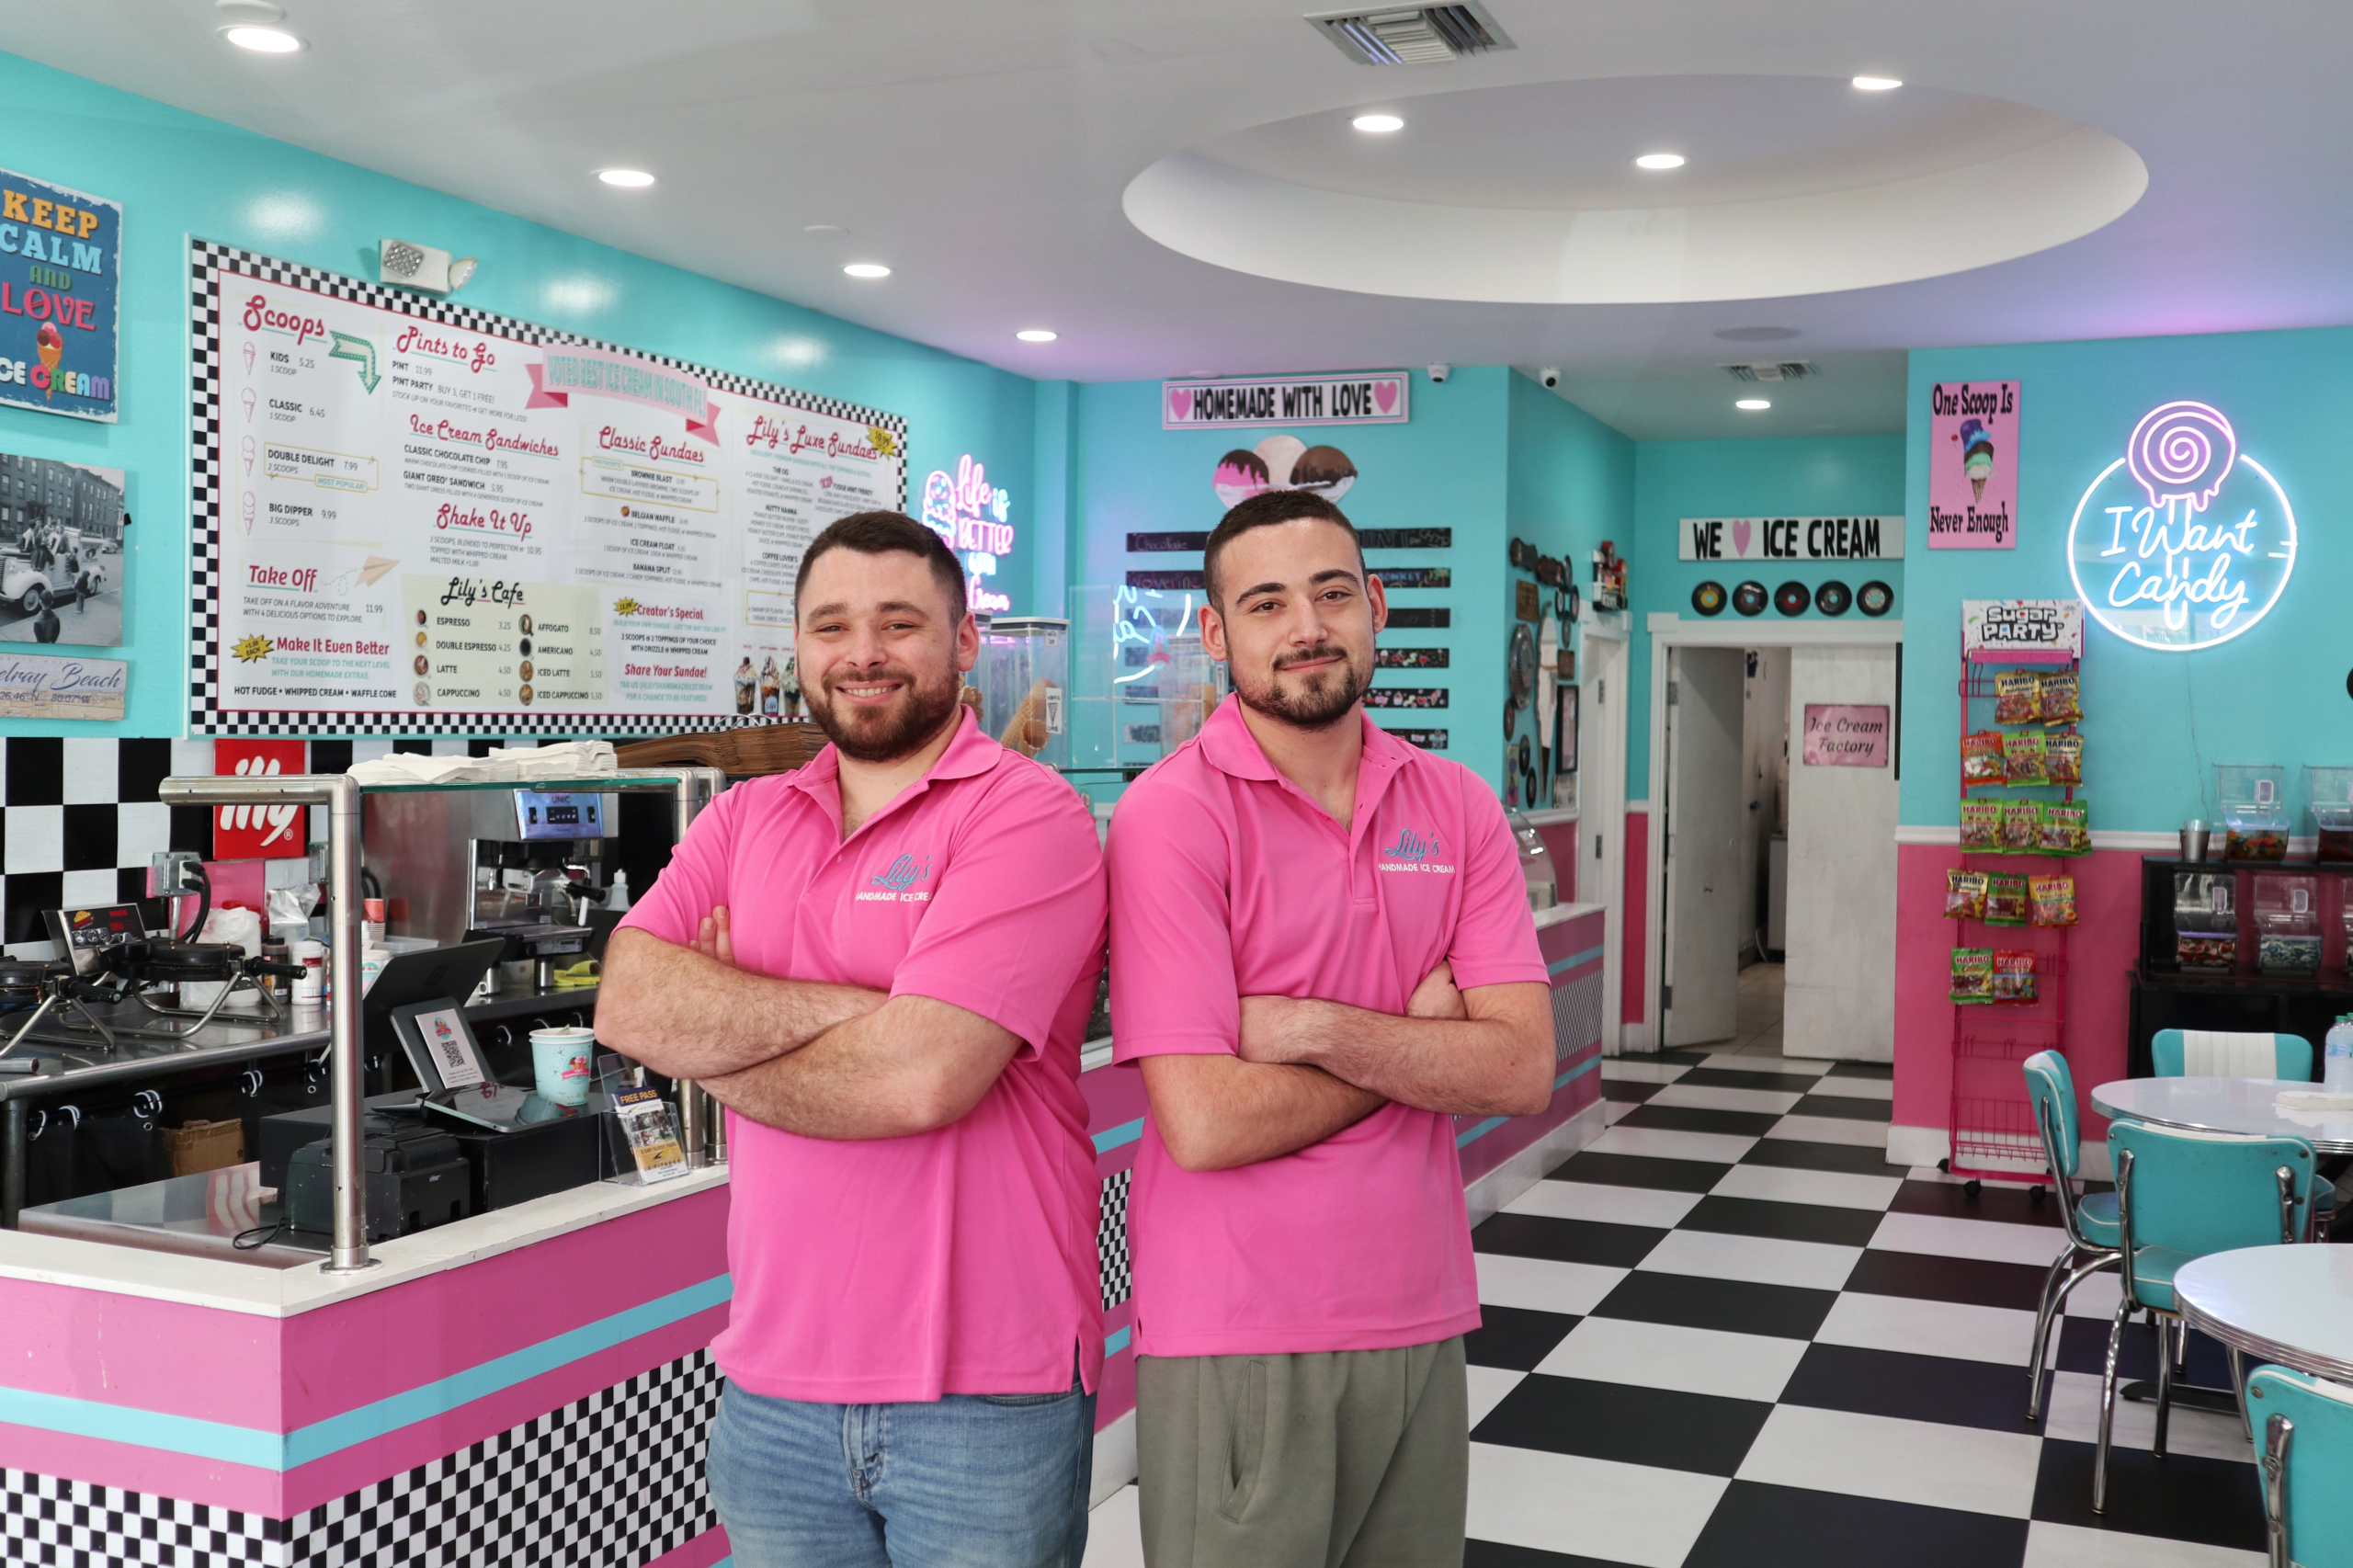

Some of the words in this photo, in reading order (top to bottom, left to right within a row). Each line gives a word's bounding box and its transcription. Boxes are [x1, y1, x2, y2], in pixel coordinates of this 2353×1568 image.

[3, 189, 99, 240] KEEP
[0, 222, 102, 276] CALM
[29, 265, 72, 290] AND
[2, 281, 96, 331] LOVE
[244, 295, 324, 346] Scoops
[396, 326, 448, 353] Pints
[453, 342, 468, 359] to
[471, 342, 495, 373] Go
[270, 352, 289, 363] KIDS
[299, 358, 314, 369] 5.25
[392, 360, 408, 371] PINT
[415, 365, 432, 376] 11.99
[0, 357, 26, 385] CE
[30, 364, 110, 401] CREAM
[548, 355, 578, 386] VOTED
[580, 358, 603, 390] BEST
[605, 361, 620, 391] ICE
[621, 365, 652, 399] CREAM
[392, 376, 409, 388] PINT
[411, 380, 433, 392] PARTY
[438, 385, 451, 394] BUY
[460, 390, 472, 400] GET
[477, 392, 494, 404] FREE!
[269, 399, 302, 413] CLASSIC
[310, 407, 325, 417] 6.45
[1194, 387, 1274, 420] HOMEMADE
[1283, 385, 1323, 417] WITH
[1333, 383, 1371, 416] LOVE
[1933, 383, 1958, 415] One
[1961, 383, 1997, 425] Scoop
[2000, 384, 2013, 414] Is
[410, 414, 434, 435] Ice
[438, 419, 483, 443] Cream
[484, 428, 559, 457] Sandwiches
[599, 426, 646, 452] Classic
[649, 436, 704, 462] Sundaes
[746, 415, 789, 449] Lily's
[790, 425, 824, 454] Luxe
[828, 432, 877, 460] Sundaes
[268, 449, 300, 462] DOUBLE
[302, 454, 335, 468] DELIGHT
[344, 461, 358, 471] 7.99
[404, 445, 433, 457] CLASSIC
[435, 449, 473, 463] CHOCOLATE
[475, 456, 490, 465] CHIP
[318, 478, 335, 486] MOST
[404, 471, 425, 482] GIANT
[449, 477, 484, 489] SANDWICH
[491, 483, 503, 493] 5.95
[269, 504, 283, 514] BIG
[285, 506, 313, 517] DIPPER
[322, 510, 335, 519] 9.99
[631, 511, 654, 520] BELGIAN
[654, 514, 675, 523] WAFFLE
[437, 504, 484, 529] Shake
[490, 510, 506, 530] It
[510, 513, 531, 541] Up
[1930, 506, 1963, 533] Never
[1967, 501, 2008, 543] Enough
[1694, 521, 1722, 560] WE
[1763, 519, 1799, 557] ICE
[1808, 517, 1880, 559] CREAM
[2101, 506, 2133, 557] I
[2131, 506, 2257, 559] Want
[249, 565, 288, 585] Take
[292, 569, 318, 593] Off
[440, 577, 487, 607] Lily's
[491, 581, 524, 608] Cafe
[2109, 552, 2249, 629] Candy
[637, 605, 674, 617] Creator's
[676, 608, 703, 620] Special
[1987, 607, 2057, 623] Sugar
[437, 618, 470, 627] ESPRESSO
[538, 624, 568, 632] AFFOGATO
[1982, 623, 2059, 642] PARTY
[277, 637, 310, 652] Make
[313, 639, 322, 653] It
[325, 640, 352, 653] Even
[356, 641, 389, 655] Better
[436, 642, 463, 650] DOUBLE
[464, 642, 496, 652] ESPRESSO
[538, 646, 573, 654] AMERICANO
[0, 662, 47, 693] elray
[50, 663, 121, 690] Beach
[437, 665, 457, 674] LATTE
[498, 666, 511, 675] 4.50
[538, 668, 551, 676] ICED
[551, 669, 570, 677] LATTE
[625, 664, 651, 676] Share
[654, 665, 672, 676] Your
[674, 666, 707, 677] Sundae!
[2001, 676, 2035, 687] HARIBO
[2041, 676, 2075, 687] HARIBO
[234, 687, 250, 695] HOT
[253, 687, 277, 696] FUDGE
[285, 687, 317, 697] WHIPPED
[320, 688, 344, 697] CREAM
[351, 689, 377, 698] WAFFLE
[379, 689, 396, 699] CONE
[438, 688, 480, 698] CAPPUCCINO
[551, 691, 588, 699] CAPPUCCINO
[1810, 717, 1831, 732] Ice
[1837, 718, 1882, 733] Cream
[1819, 737, 1874, 757] Factory
[2006, 738, 2039, 747] HARIBO
[2005, 807, 2038, 815] HARIBO
[2049, 808, 2084, 819] HARIBO
[1385, 828, 1439, 862] Lily's
[871, 854, 933, 891] Lily's
[1420, 864, 1430, 872] ICE
[1433, 865, 1455, 873] CREAM
[1951, 875, 1984, 885] HARIBO
[1993, 879, 2025, 887] HARIBO
[2035, 882, 2069, 892] HARIBO
[900, 892, 914, 902] ICE
[915, 892, 932, 901] CRE
[1956, 955, 1990, 964] HARIBO
[620, 1094, 639, 1104] FREE
[639, 1090, 657, 1099] PASS
